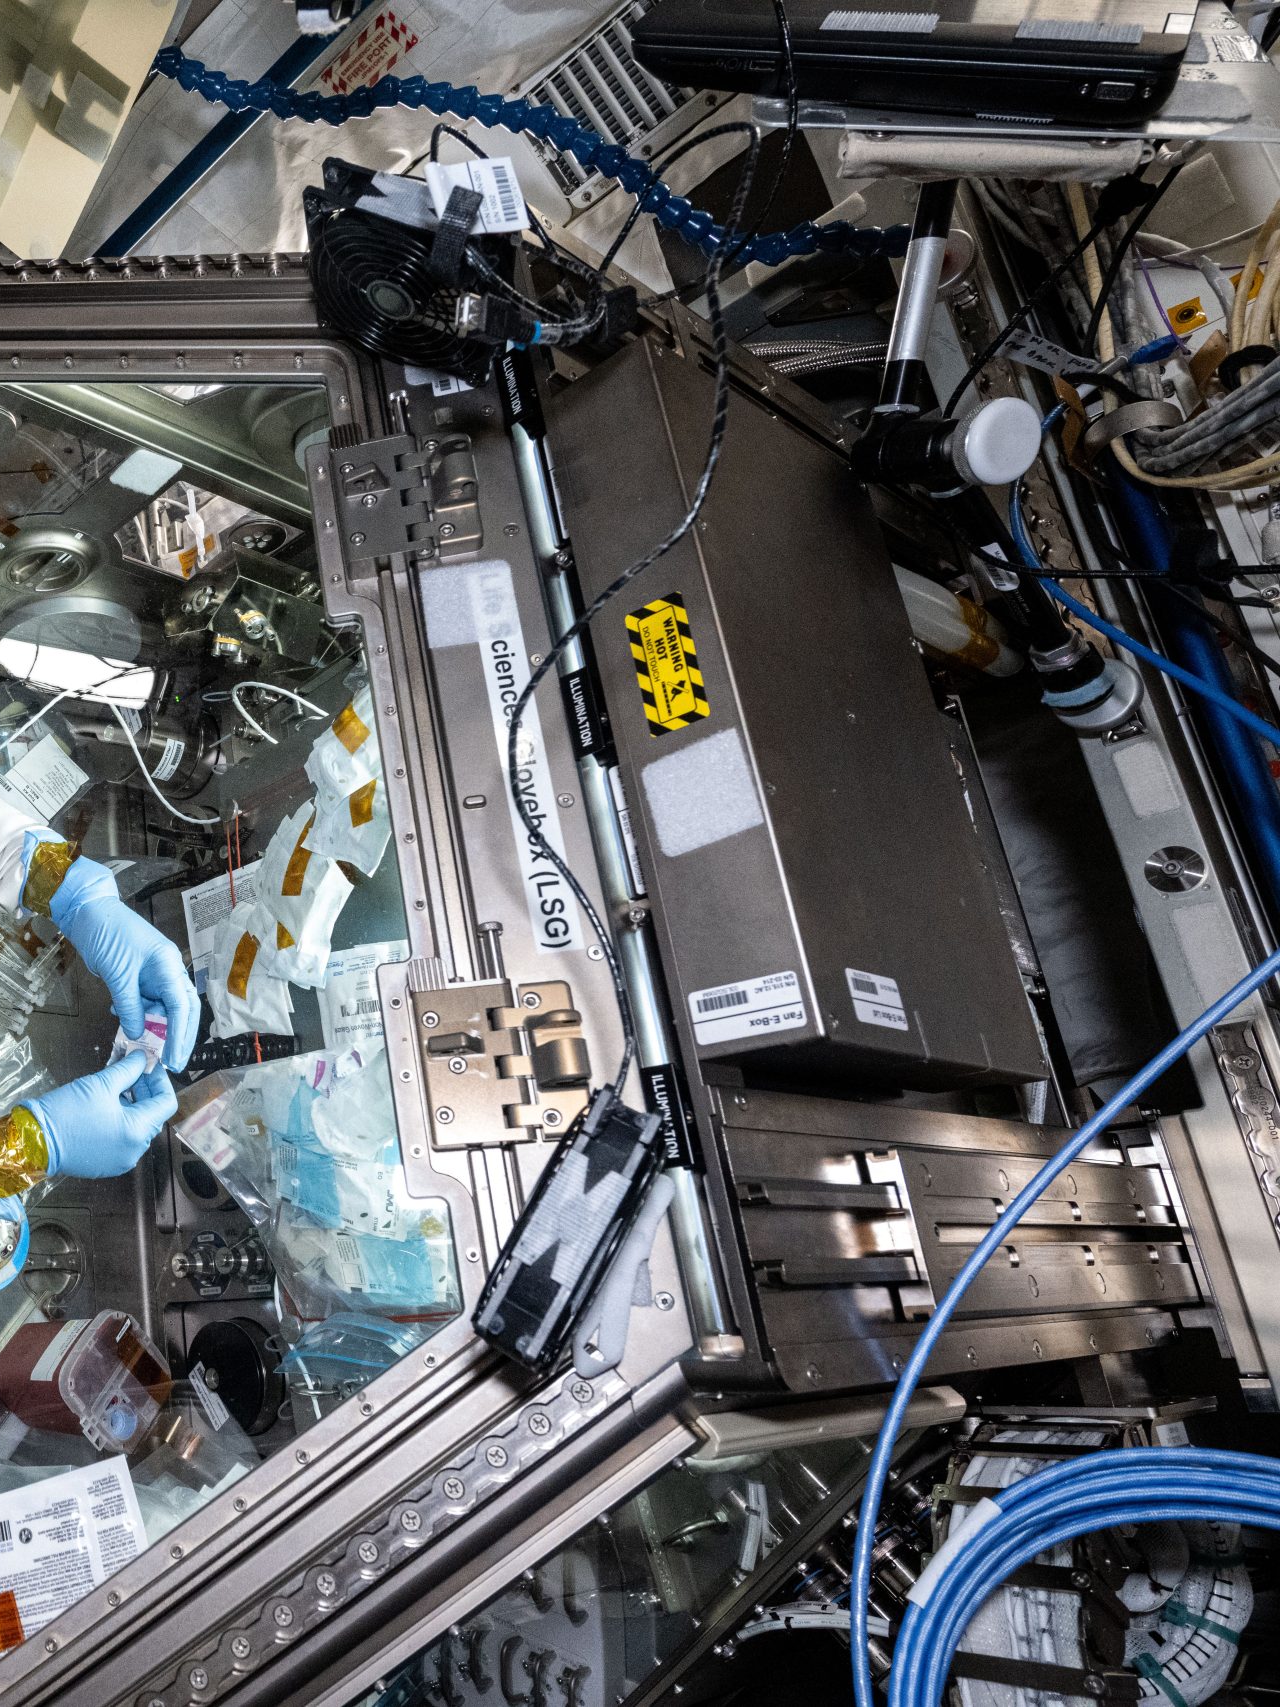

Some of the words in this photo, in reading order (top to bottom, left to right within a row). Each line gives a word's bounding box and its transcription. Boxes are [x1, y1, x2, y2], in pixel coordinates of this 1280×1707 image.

[339, 41, 374, 77] EMERGENCY
[372, 30, 385, 44] USE
[345, 59, 368, 83] FIRE
[365, 36, 392, 63] PORT
[501, 355, 522, 415] ILLUMINATION
[641, 625, 650, 638] DO
[644, 638, 654, 655] NOT
[653, 636, 668, 661] HOT
[662, 616, 684, 672] WARNING
[648, 656, 660, 682] TOUCH
[568, 676, 593, 747] ILLUMINATION
[527, 868, 572, 951] (LSG)
[748, 1014, 781, 1028] E-Box
[782, 1010, 803, 1022] Fan
[650, 1073, 680, 1159] ILLUMNTION
[376, 1170, 383, 1180] EO
